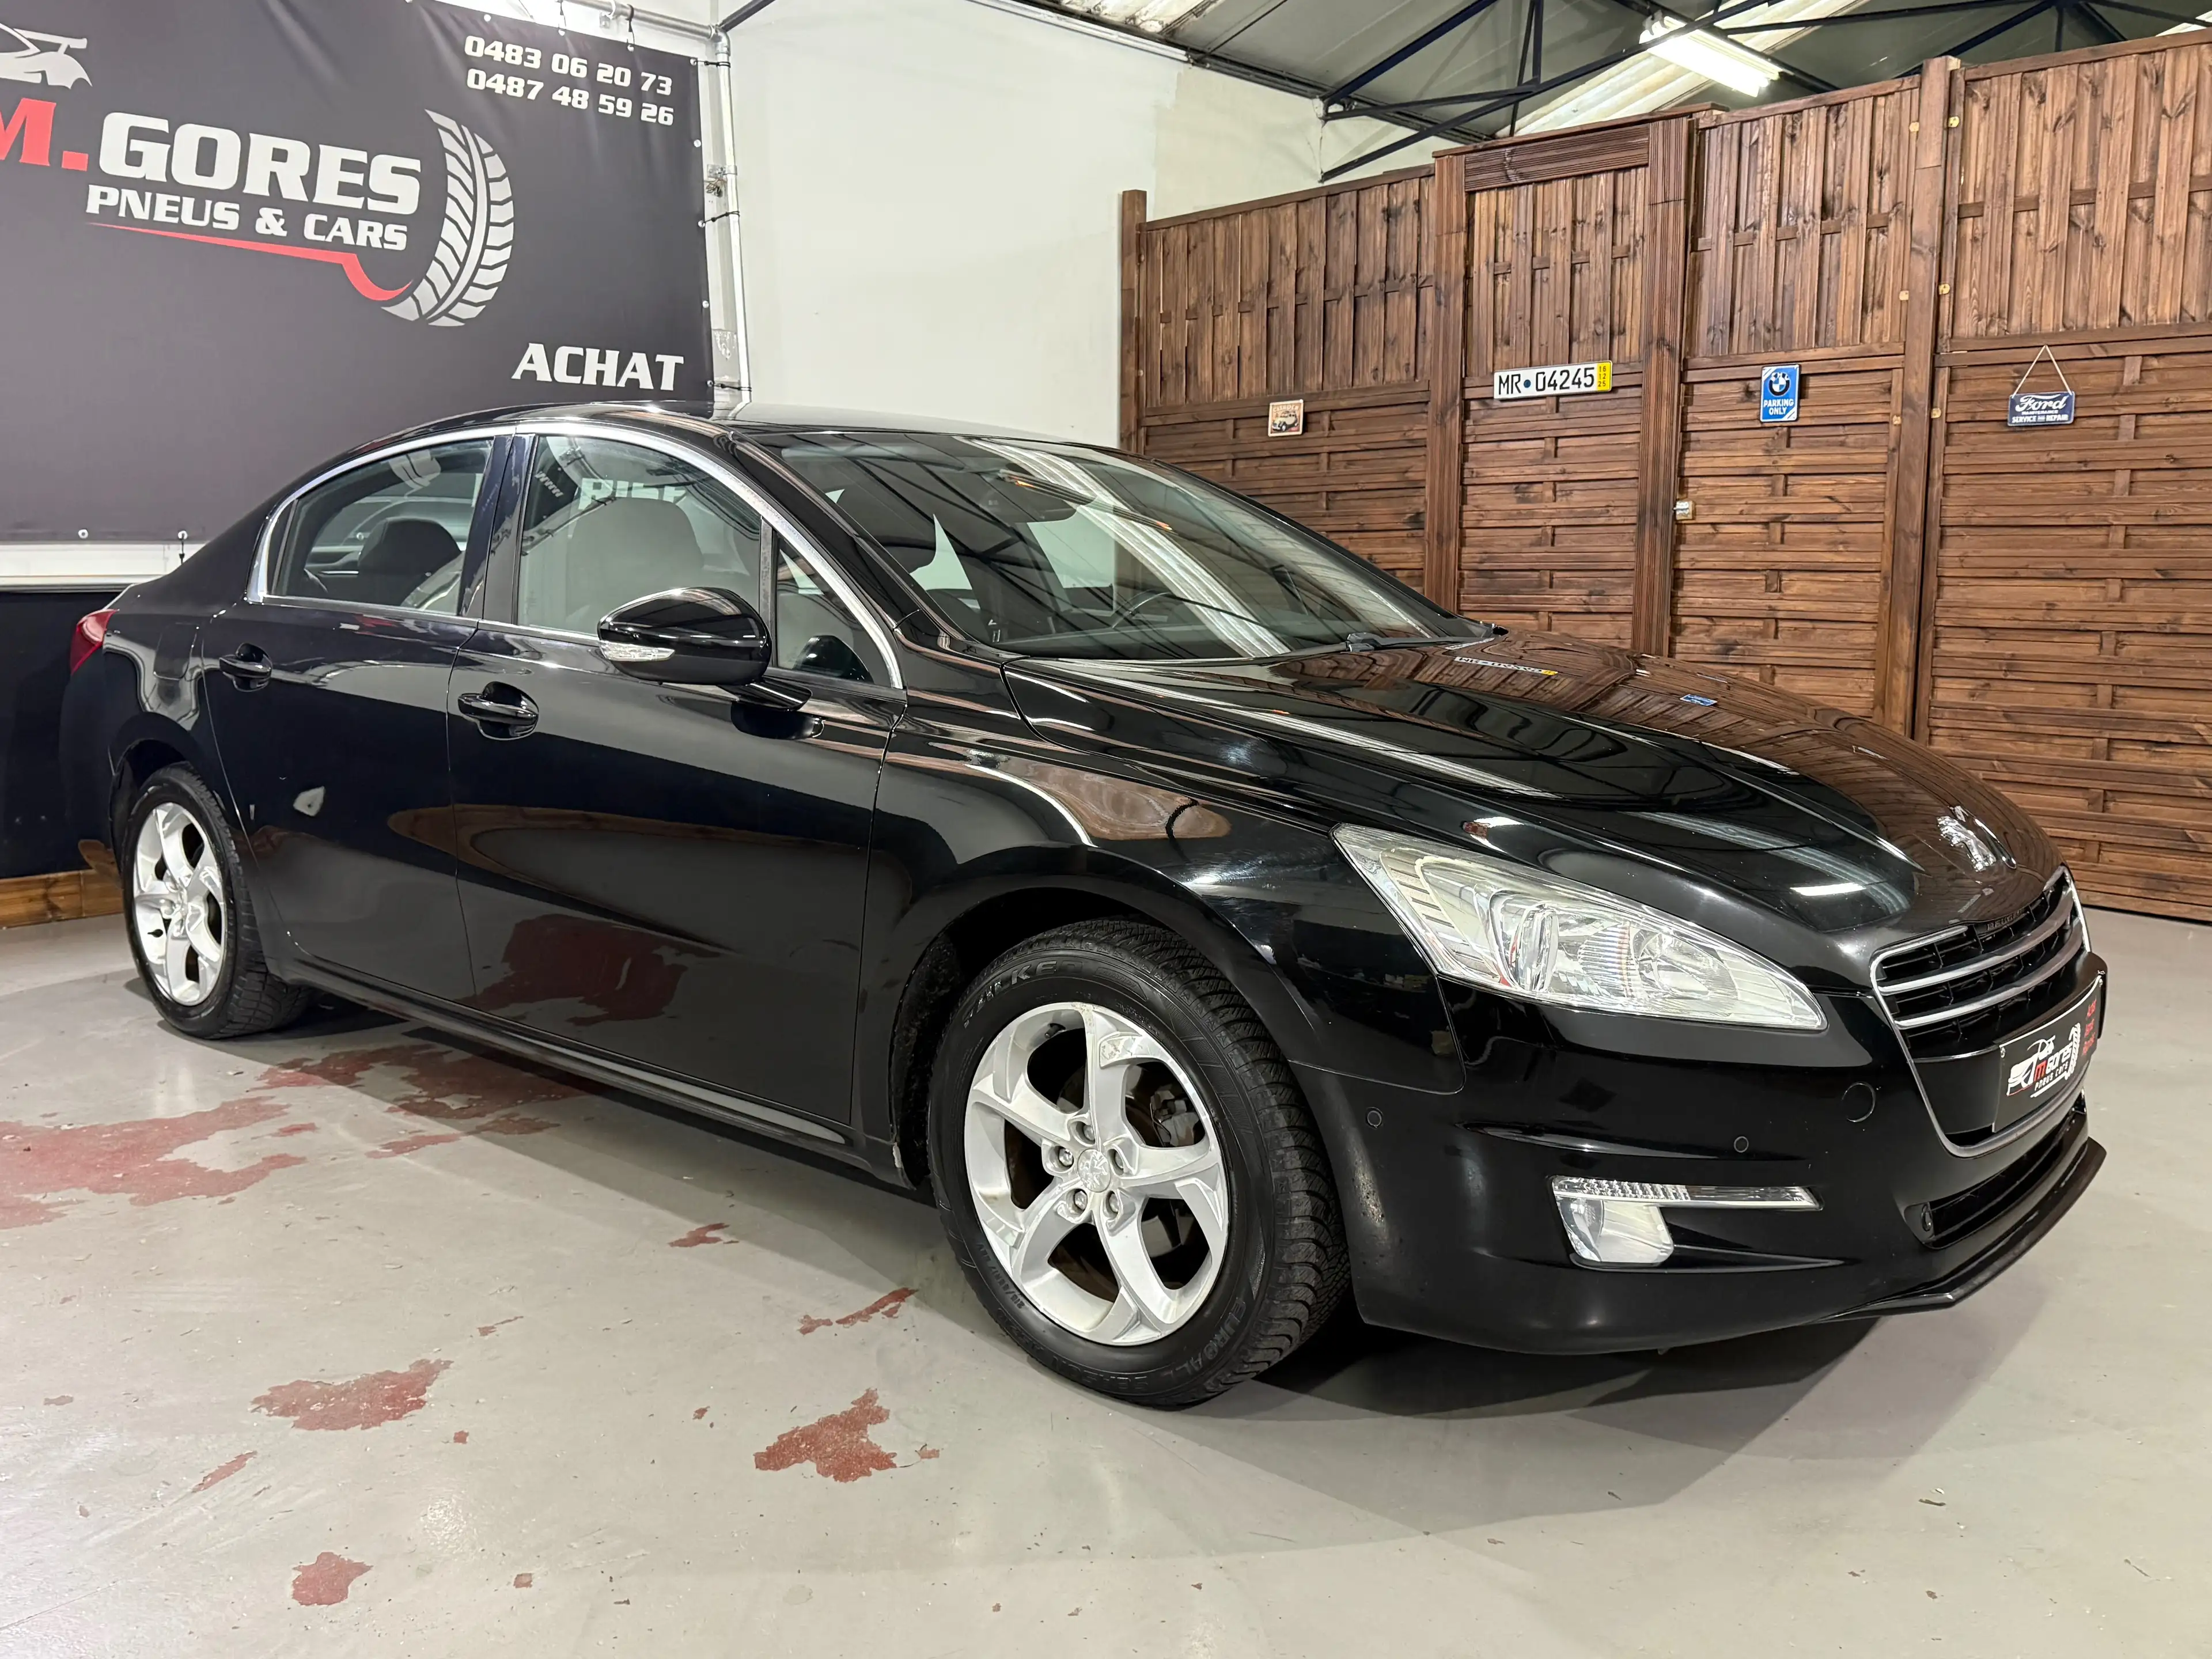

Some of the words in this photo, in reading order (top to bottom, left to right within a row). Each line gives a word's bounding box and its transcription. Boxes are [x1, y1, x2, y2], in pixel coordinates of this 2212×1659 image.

[464, 35, 541, 69] 0483
[551, 53, 588, 78] 06
[596, 62, 631, 87] 20
[641, 72, 673, 96] 73
[467, 68, 544, 100] 0487
[552, 86, 589, 109] 48
[598, 93, 632, 118] 59
[641, 103, 674, 126] 26
[86, 184, 240, 230] PNEUS
[255, 207, 287, 237] &
[304, 213, 407, 251] CARS
[511, 343, 684, 391] ACHAT
[1498, 374, 1521, 395] MR
[1535, 367, 1595, 392] 04245
[1763, 399, 1794, 407] PARKING
[1768, 407, 1787, 415] ONLY
[2015, 393, 2069, 412] Ford
[2012, 415, 2037, 423] SERVICE
